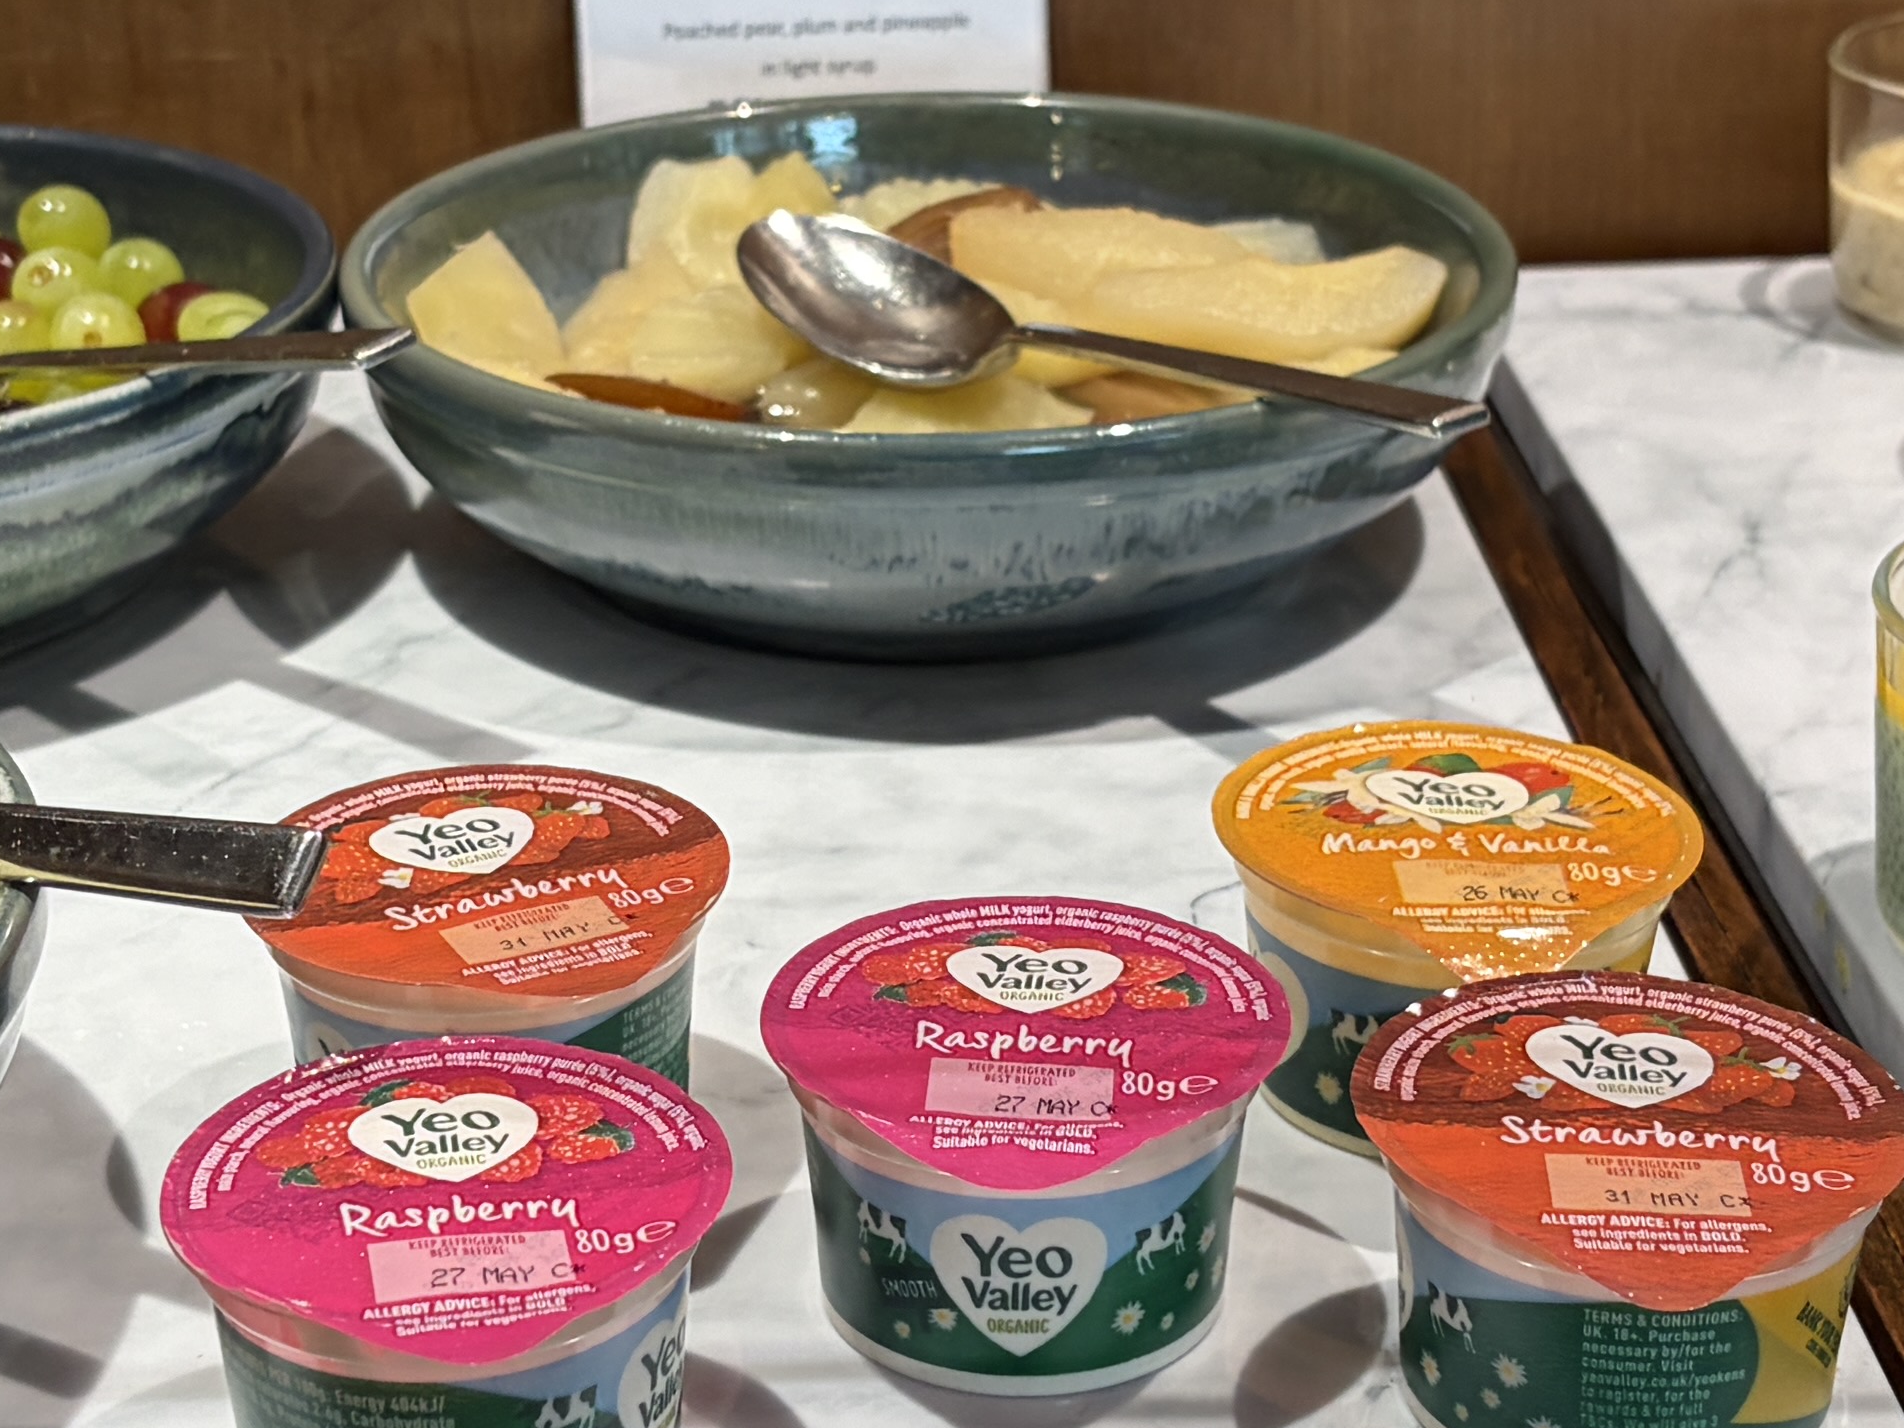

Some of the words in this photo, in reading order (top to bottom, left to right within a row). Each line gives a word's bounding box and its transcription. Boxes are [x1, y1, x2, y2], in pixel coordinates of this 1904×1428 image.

[844, 14, 877, 34] and
[1393, 776, 1497, 795] Yeo
[1397, 790, 1505, 811] Valley
[394, 818, 501, 845] Yeo
[407, 830, 515, 861] Valley
[1321, 831, 1437, 860] Mango
[1446, 832, 1470, 856] &
[1477, 831, 1612, 856] Vanilla
[383, 867, 629, 931] Strawberry
[1462, 884, 1488, 902] 26
[1500, 886, 1540, 902] MAY
[499, 936, 528, 951] 31
[542, 922, 590, 943] MAY
[981, 952, 1089, 975] Yeo
[976, 971, 1093, 995] Valley
[998, 989, 1066, 1003] ORGANIC
[914, 1020, 1135, 1067] Raspberry
[1560, 1034, 1679, 1068] Yeo
[1562, 1059, 1688, 1088] Valley
[1596, 1082, 1667, 1097] ORGANIC
[995, 1094, 1026, 1114] 27
[1036, 1097, 1082, 1115] MAY
[381, 1107, 501, 1137] Yeo
[383, 1132, 510, 1159] Valley
[1500, 1115, 1781, 1162] Strawberry
[415, 1152, 487, 1170] ORGANIC
[1604, 1189, 1632, 1205] 31
[1651, 1192, 1700, 1209] MAY
[339, 1194, 580, 1237] Raspberry
[1541, 1212, 1607, 1228] ALLERGY
[961, 1231, 1074, 1279] Yeo
[1574, 1236, 1634, 1253] Suitable
[430, 1268, 466, 1289] 27
[482, 1265, 536, 1286] MAY
[882, 1277, 938, 1299] SMOOTH
[961, 1275, 1078, 1317] Valley
[362, 1301, 434, 1321] ALLERGY
[1583, 1308, 1633, 1327] TERMS
[1636, 1314, 1646, 1327] &
[986, 1317, 1051, 1335] ORGANIC
[1648, 1329, 1717, 1342] Purchase
[641, 1315, 687, 1392] Yeo
[1581, 1341, 1659, 1360] necessary
[1660, 1343, 1706, 1360] by/for
[1708, 1341, 1732, 1355] the
[1660, 1359, 1694, 1372] Visit
[1664, 1389, 1685, 1403] for
[1687, 1388, 1711, 1401] the
[1654, 1404, 1675, 1417] for
